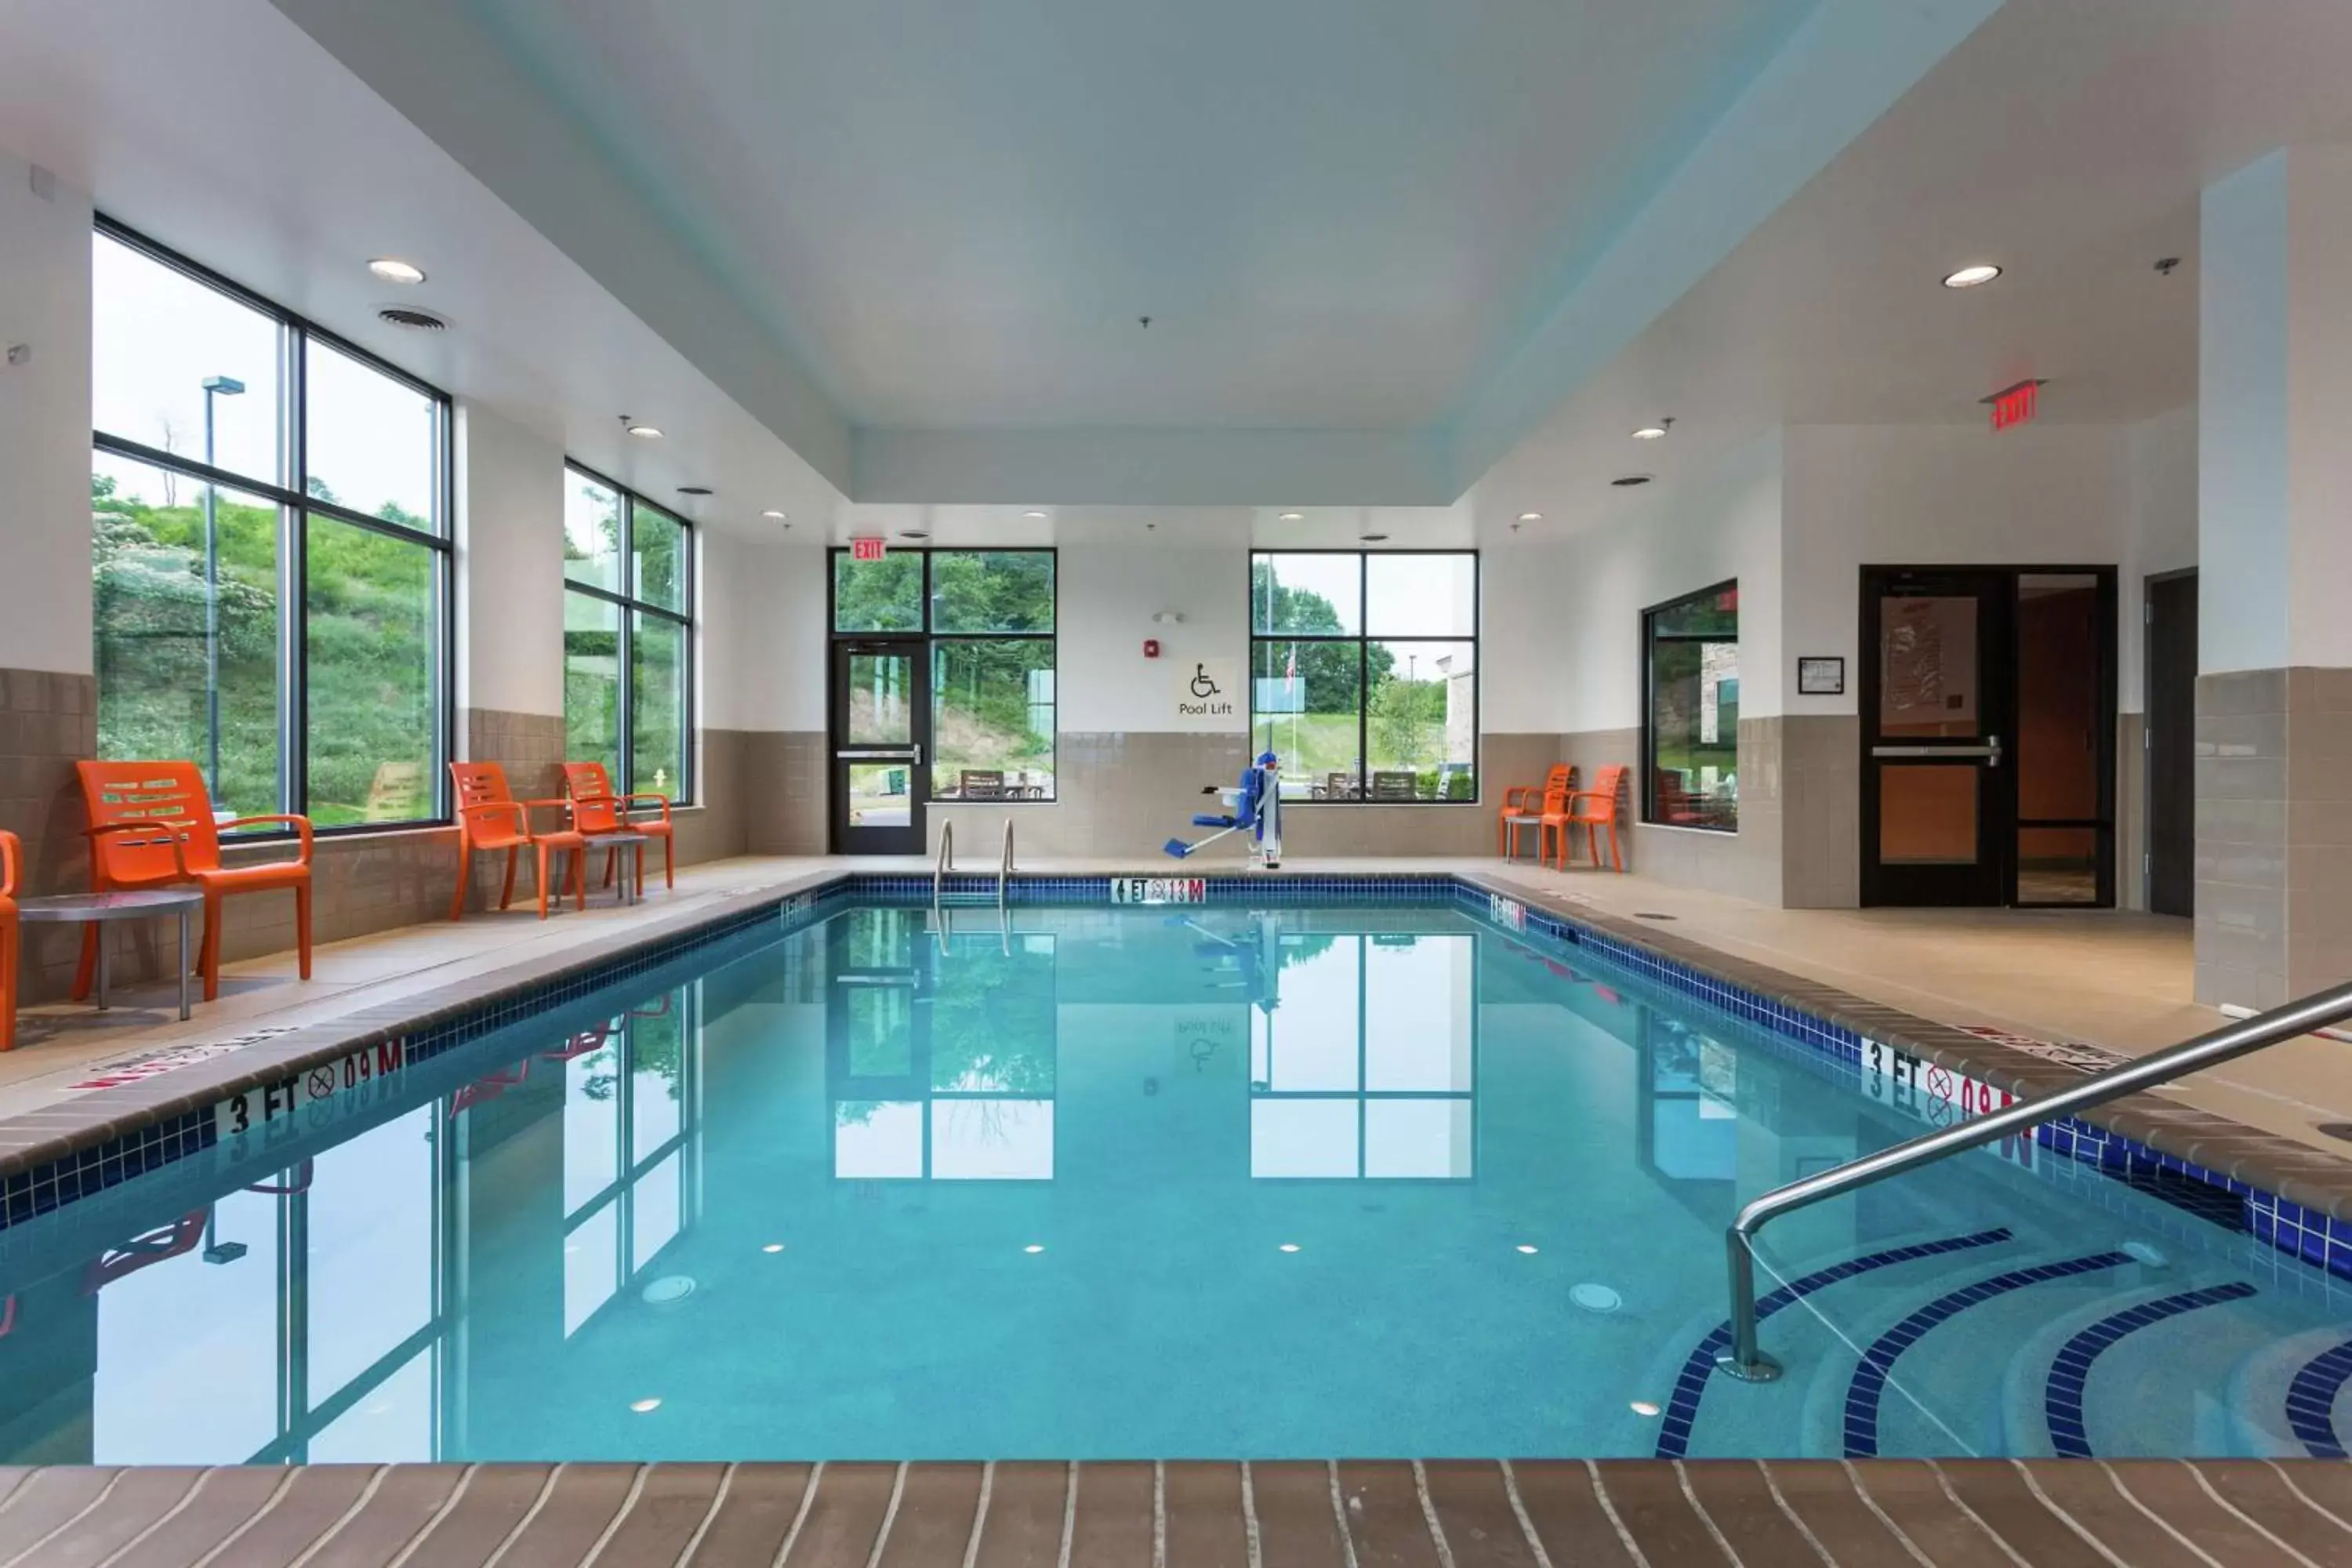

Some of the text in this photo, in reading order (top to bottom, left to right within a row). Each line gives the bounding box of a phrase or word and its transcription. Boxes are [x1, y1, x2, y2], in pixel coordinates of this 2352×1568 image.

[1995, 384, 2036, 429] EXIT
[855, 541, 882, 559] EXIT
[1179, 702, 1232, 714] Pool Lift
[230, 1094, 249, 1134] 3
[264, 1076, 299, 1122] FT
[377, 1037, 402, 1077] M
[1871, 1042, 1882, 1075] 3
[1893, 1047, 1922, 1089] FT
